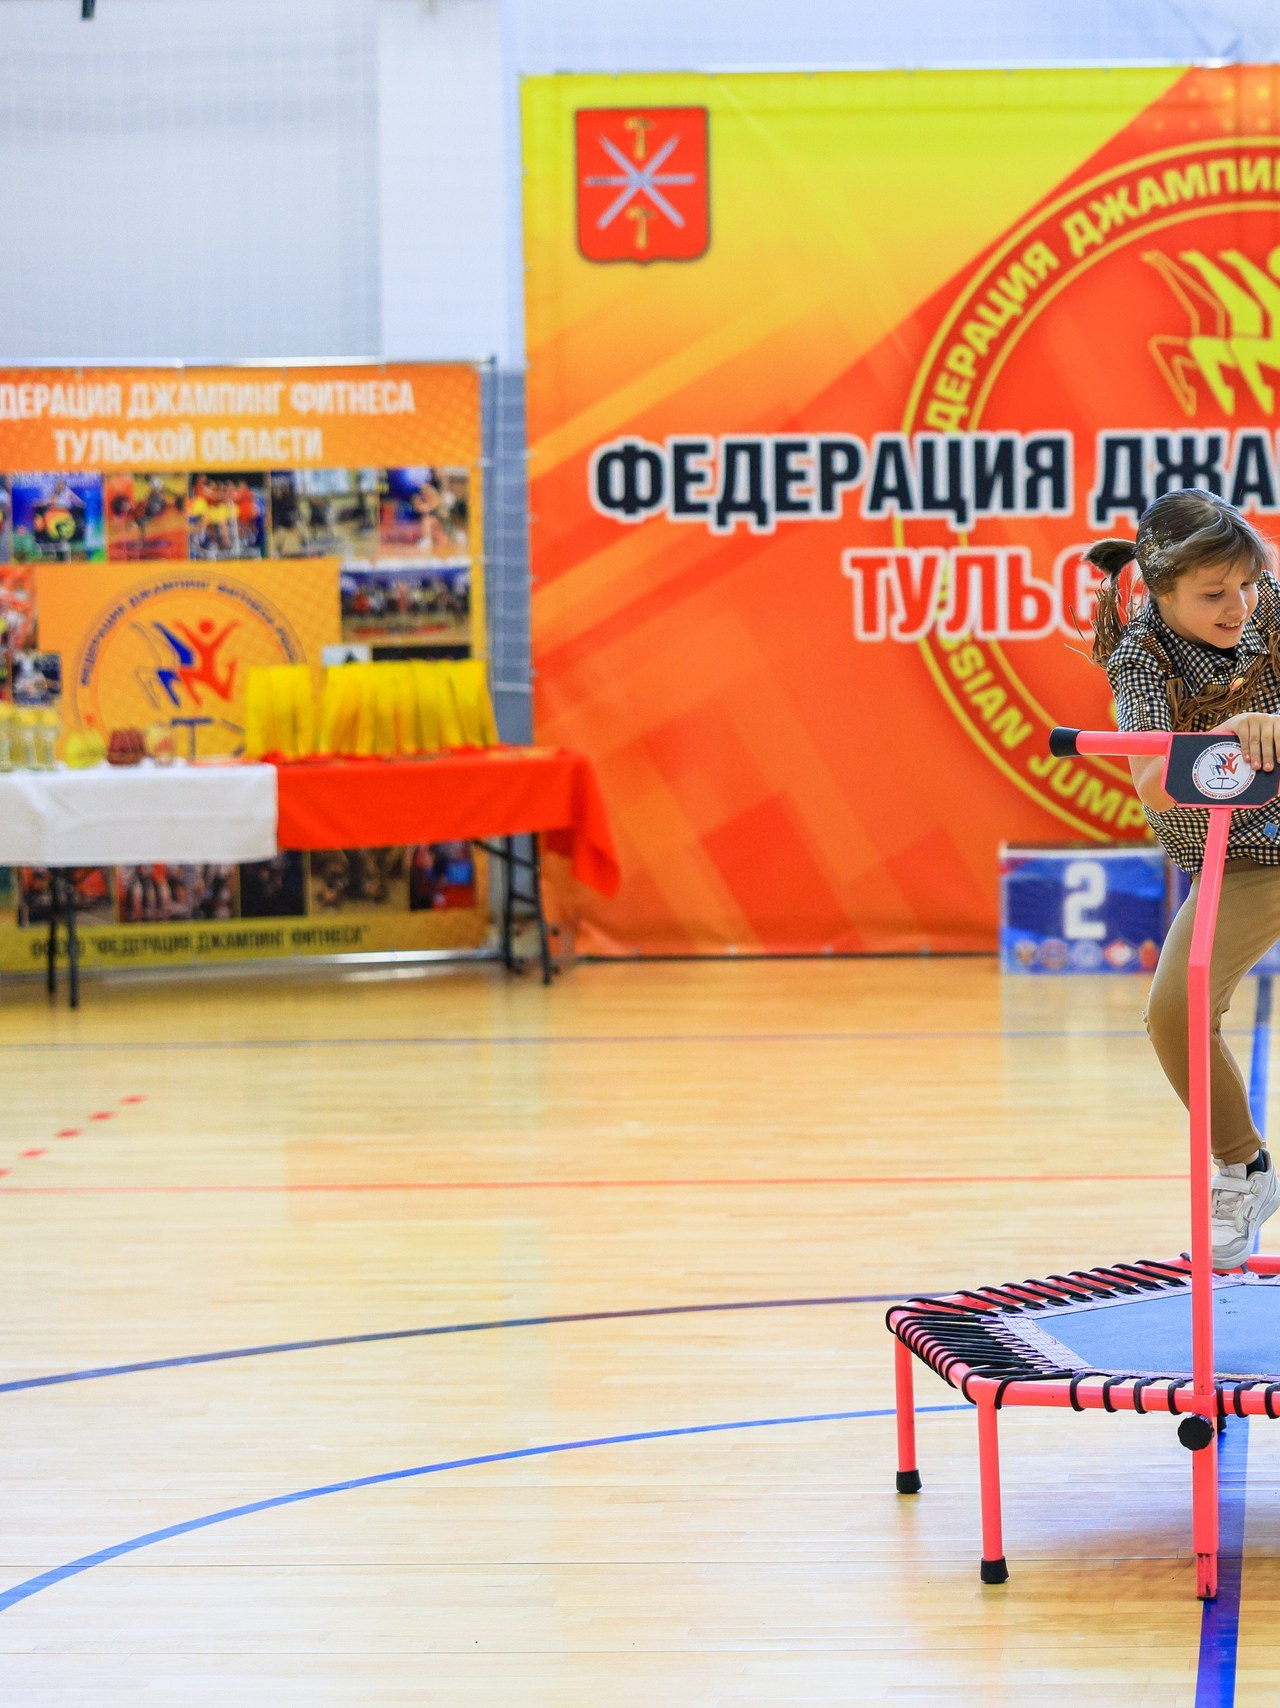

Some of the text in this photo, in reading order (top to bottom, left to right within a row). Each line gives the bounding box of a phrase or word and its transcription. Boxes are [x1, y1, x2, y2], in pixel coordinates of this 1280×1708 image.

[924, 240, 1060, 433] ДЕРАЦИЯ
[53, 423, 323, 465] ТУЛЬСКОЙ ОБЛАСТИ
[126, 381, 285, 420] ДЖАМПИНГ
[289, 379, 417, 415] ФИТНЕСА
[591, 431, 1071, 535] ФЕДЕРАЦИЯ
[843, 540, 1280, 643] ТУЛЬС
[939, 634, 1033, 749] SIAN
[1027, 752, 1155, 836] JUMP
[1063, 860, 1107, 940] 2
